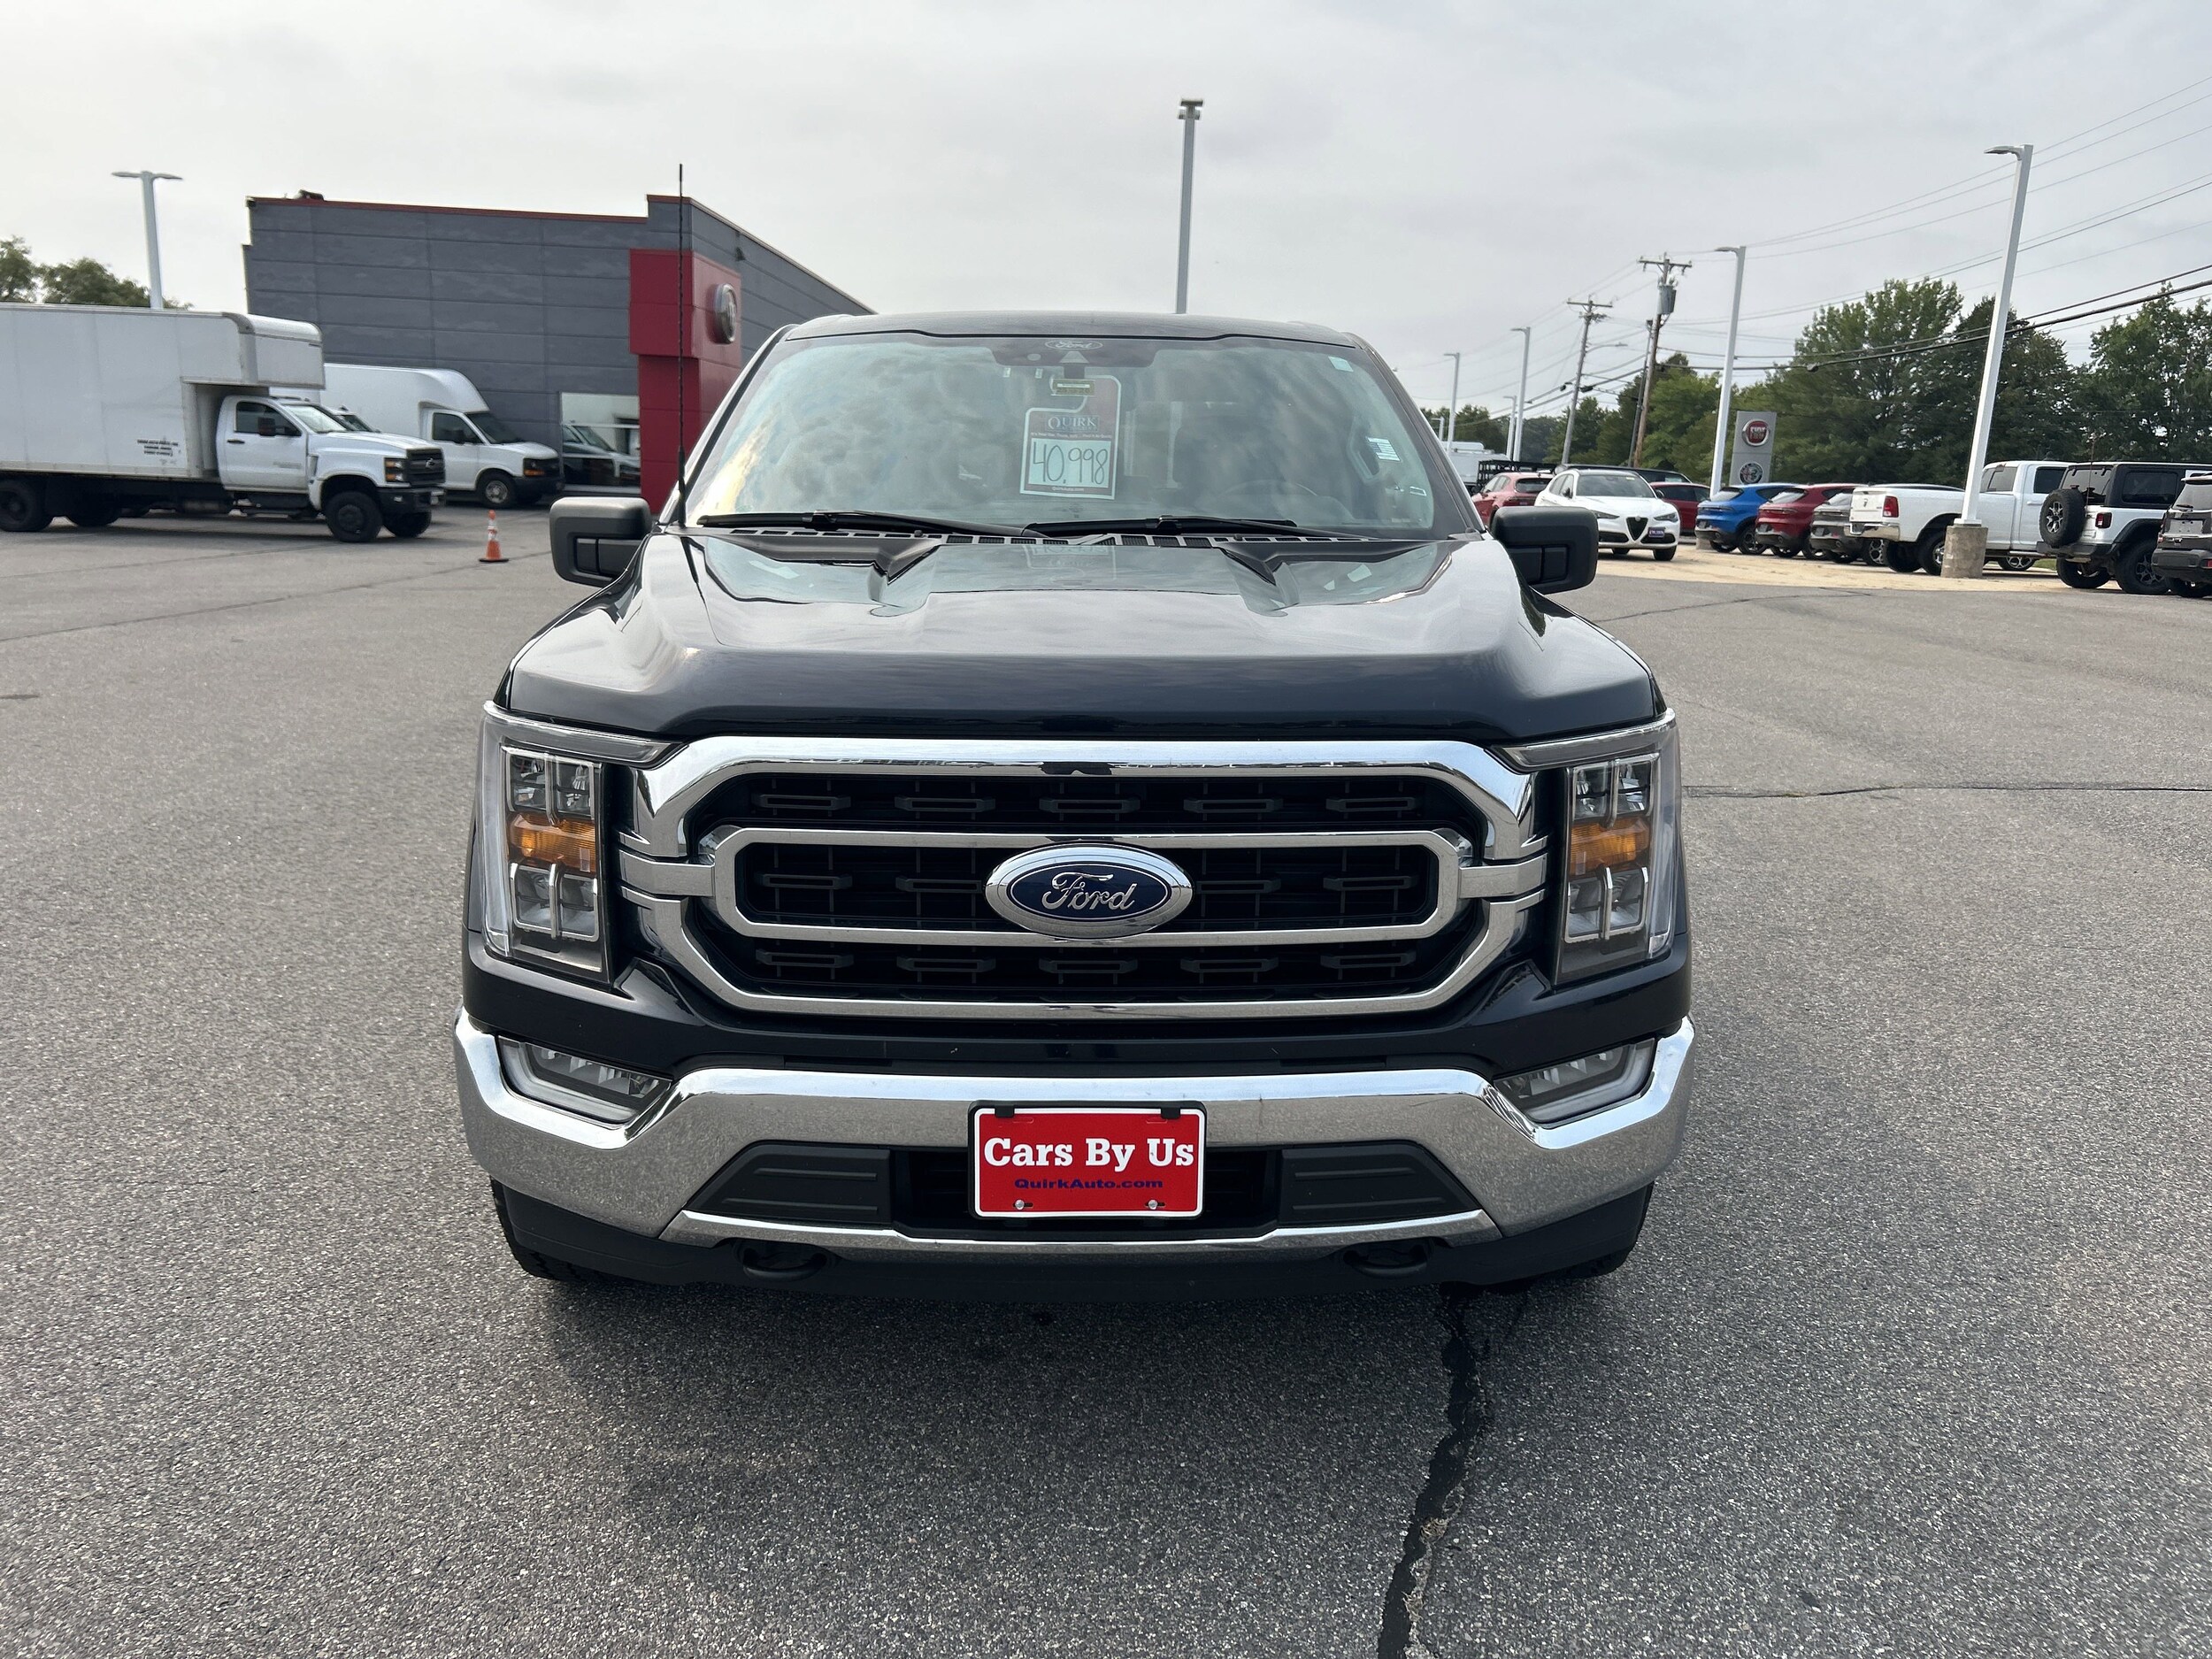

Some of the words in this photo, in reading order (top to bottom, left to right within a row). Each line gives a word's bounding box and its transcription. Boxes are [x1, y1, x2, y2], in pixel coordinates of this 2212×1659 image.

[1055, 340, 1093, 349] Ford
[1048, 416, 1096, 429] QUIRK
[1041, 871, 1138, 911] Ford
[984, 1138, 1073, 1167] Cars
[1085, 1138, 1135, 1172] By
[1147, 1138, 1194, 1167] Us
[1014, 1178, 1164, 1190] QuirkAuto.com
